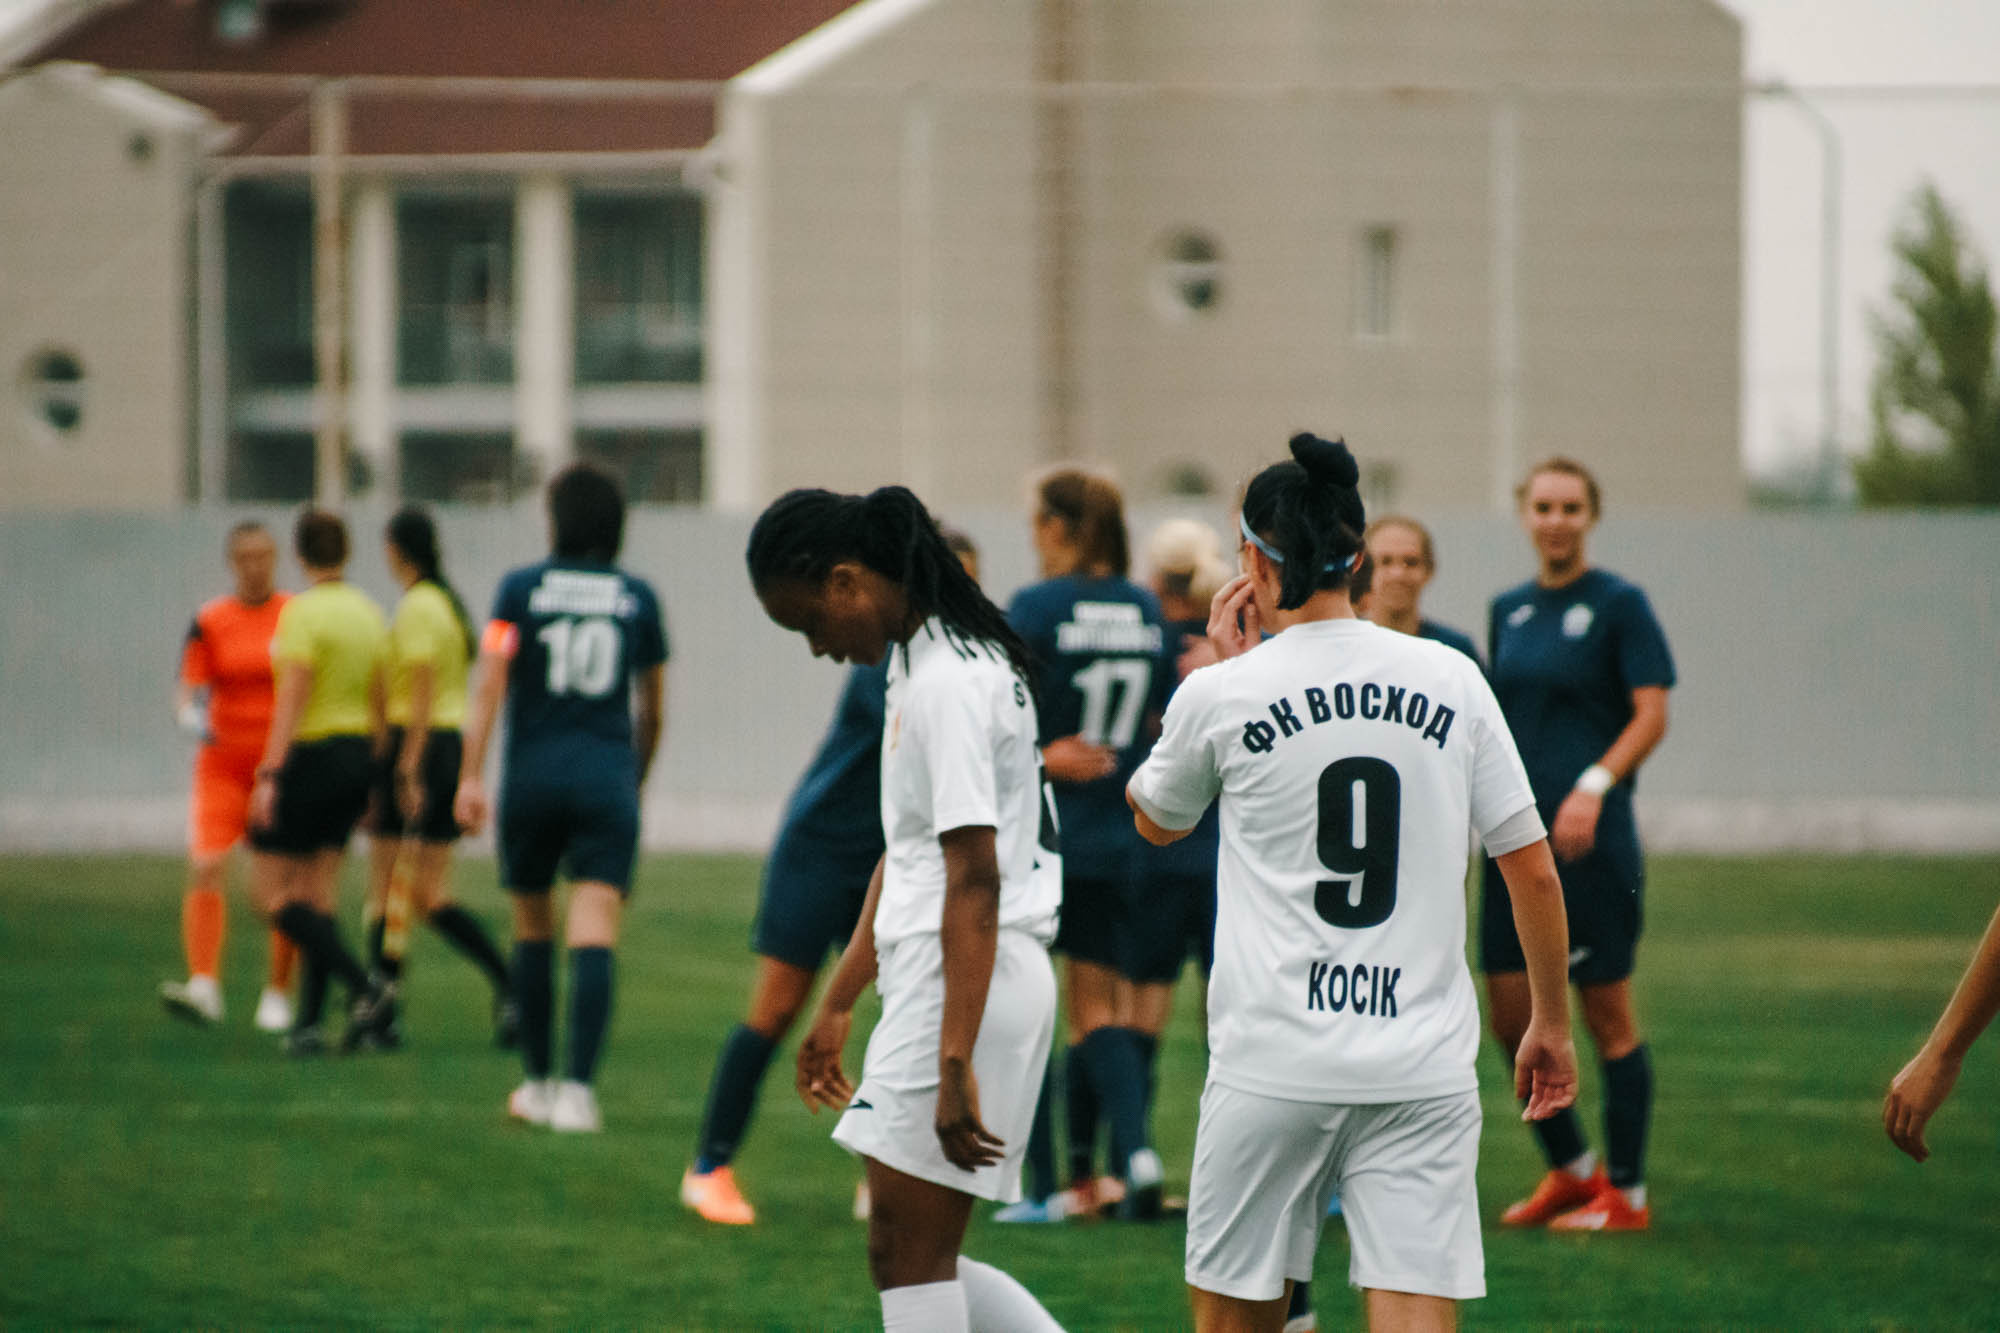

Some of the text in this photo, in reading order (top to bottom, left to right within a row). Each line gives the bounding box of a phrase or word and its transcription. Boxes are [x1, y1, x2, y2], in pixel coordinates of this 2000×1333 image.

[537, 617, 622, 696] 10
[1071, 657, 1150, 748] 17
[1242, 682, 1456, 754] ФК ВОСХОД
[1313, 756, 1401, 930] 9
[1308, 960, 1401, 1018] КОСІК
